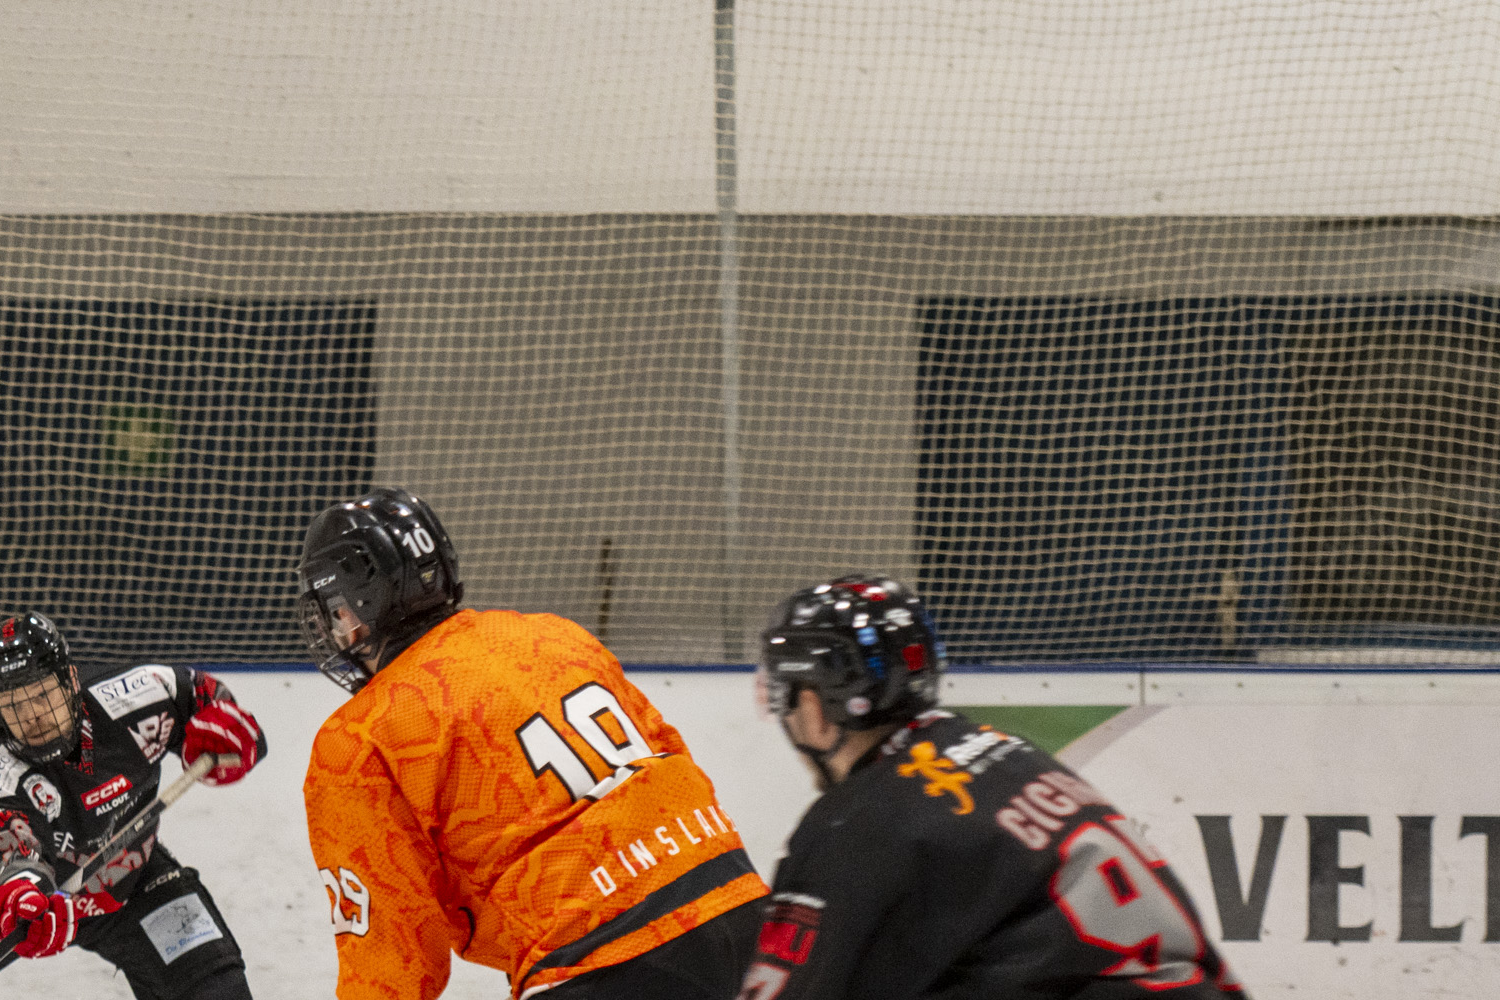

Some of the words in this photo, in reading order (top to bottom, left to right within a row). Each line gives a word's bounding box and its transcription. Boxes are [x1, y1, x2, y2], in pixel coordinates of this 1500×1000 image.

[402, 528, 435, 558] 10
[313, 574, 336, 589] CCM
[0, 659, 27, 674] CCM
[101, 674, 149, 702] SiTec
[86, 777, 127, 805] CCM
[96, 802, 113, 817] ALL
[144, 870, 181, 893] CCM
